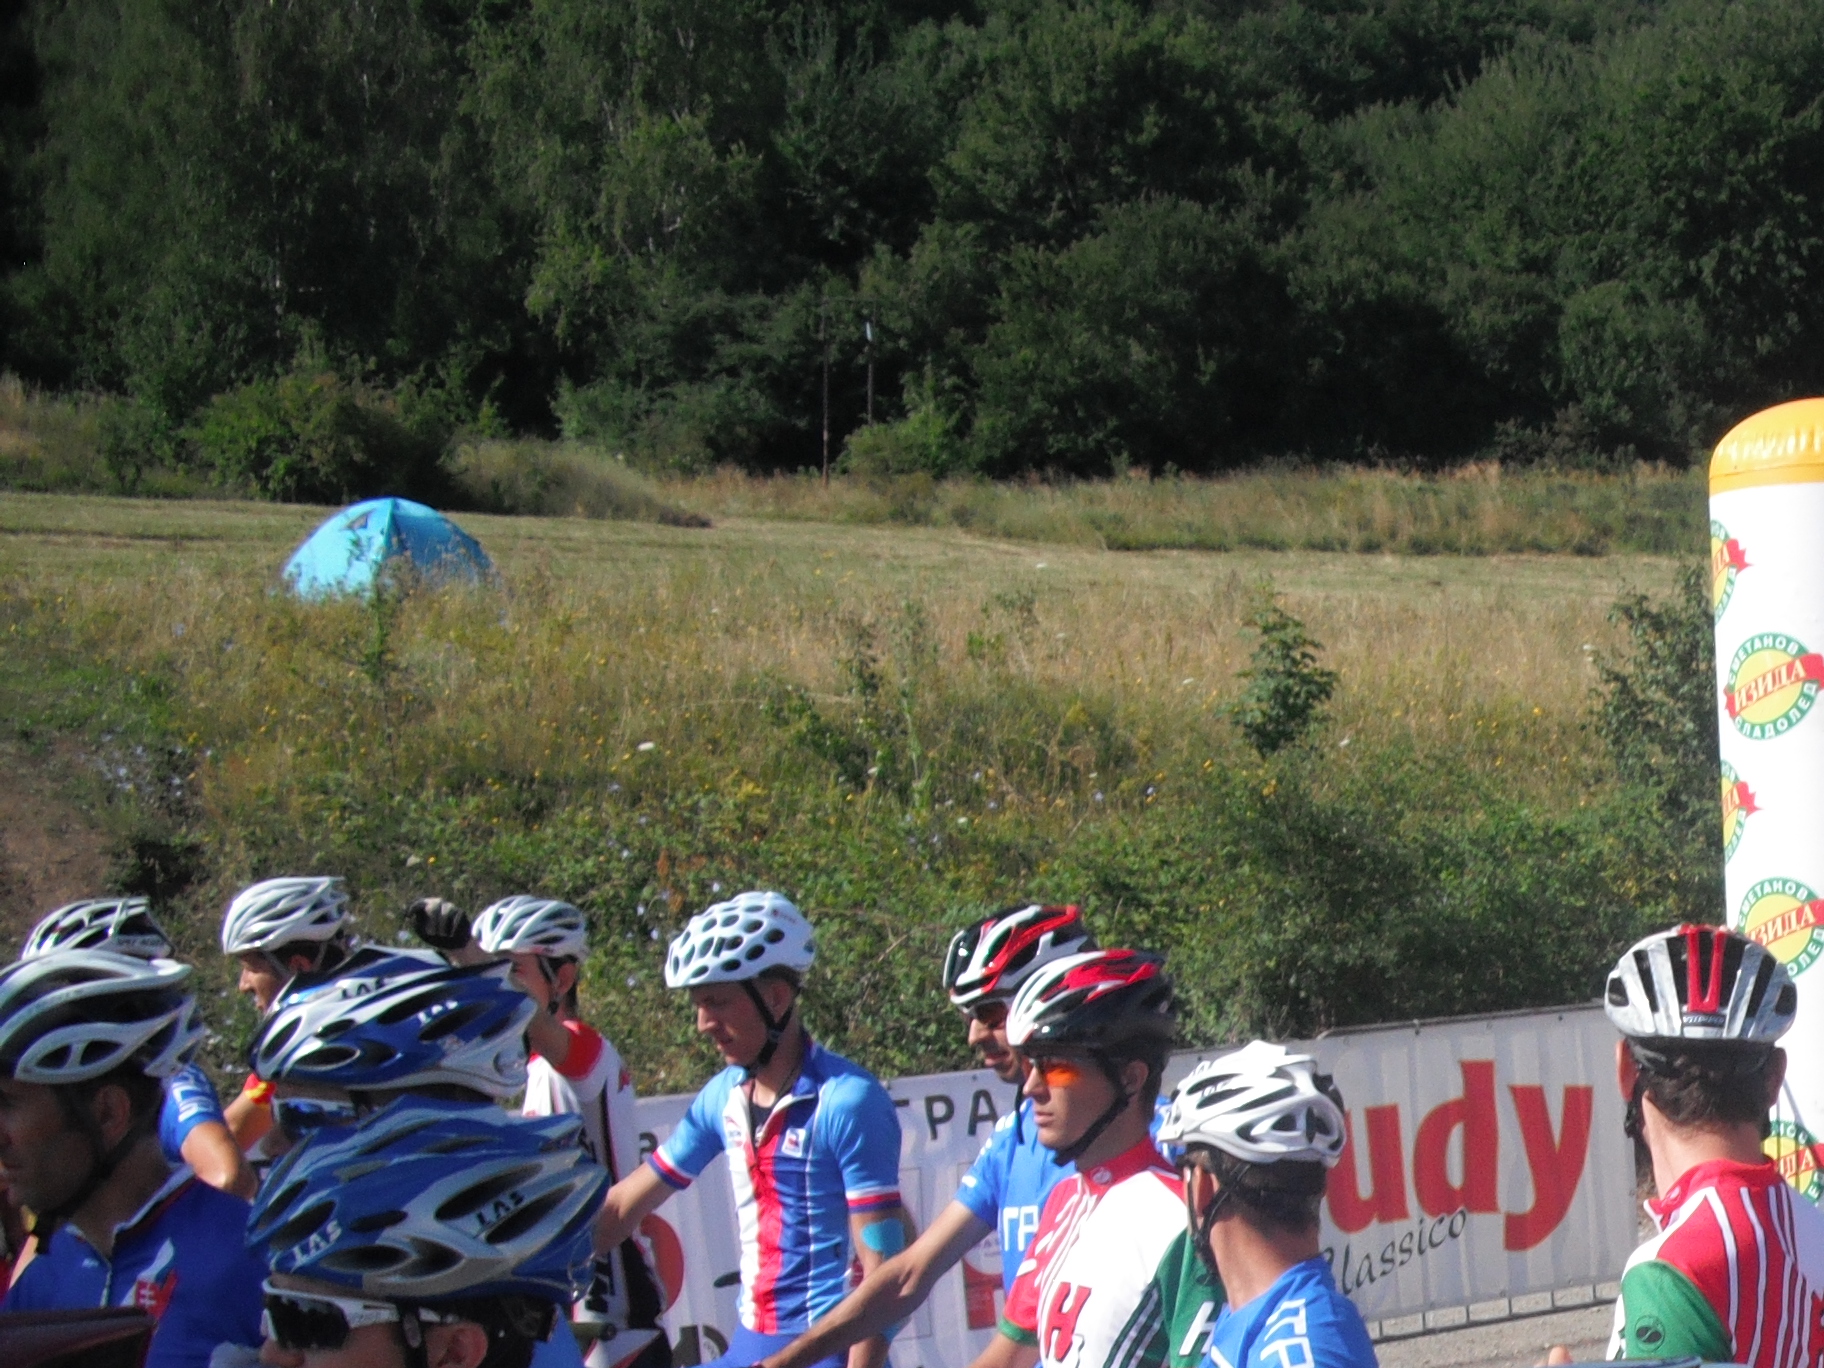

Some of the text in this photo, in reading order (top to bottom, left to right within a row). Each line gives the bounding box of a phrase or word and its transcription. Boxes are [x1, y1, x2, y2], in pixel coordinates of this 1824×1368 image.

[1729, 634, 1799, 685] СМЕТАНОВ
[1735, 658, 1806, 712] ИЗИДА
[1747, 902, 1816, 950] ЗИДА
[1325, 1059, 1594, 1252] udy
[475, 1191, 526, 1227] LAS
[292, 1219, 343, 1264] LAS
